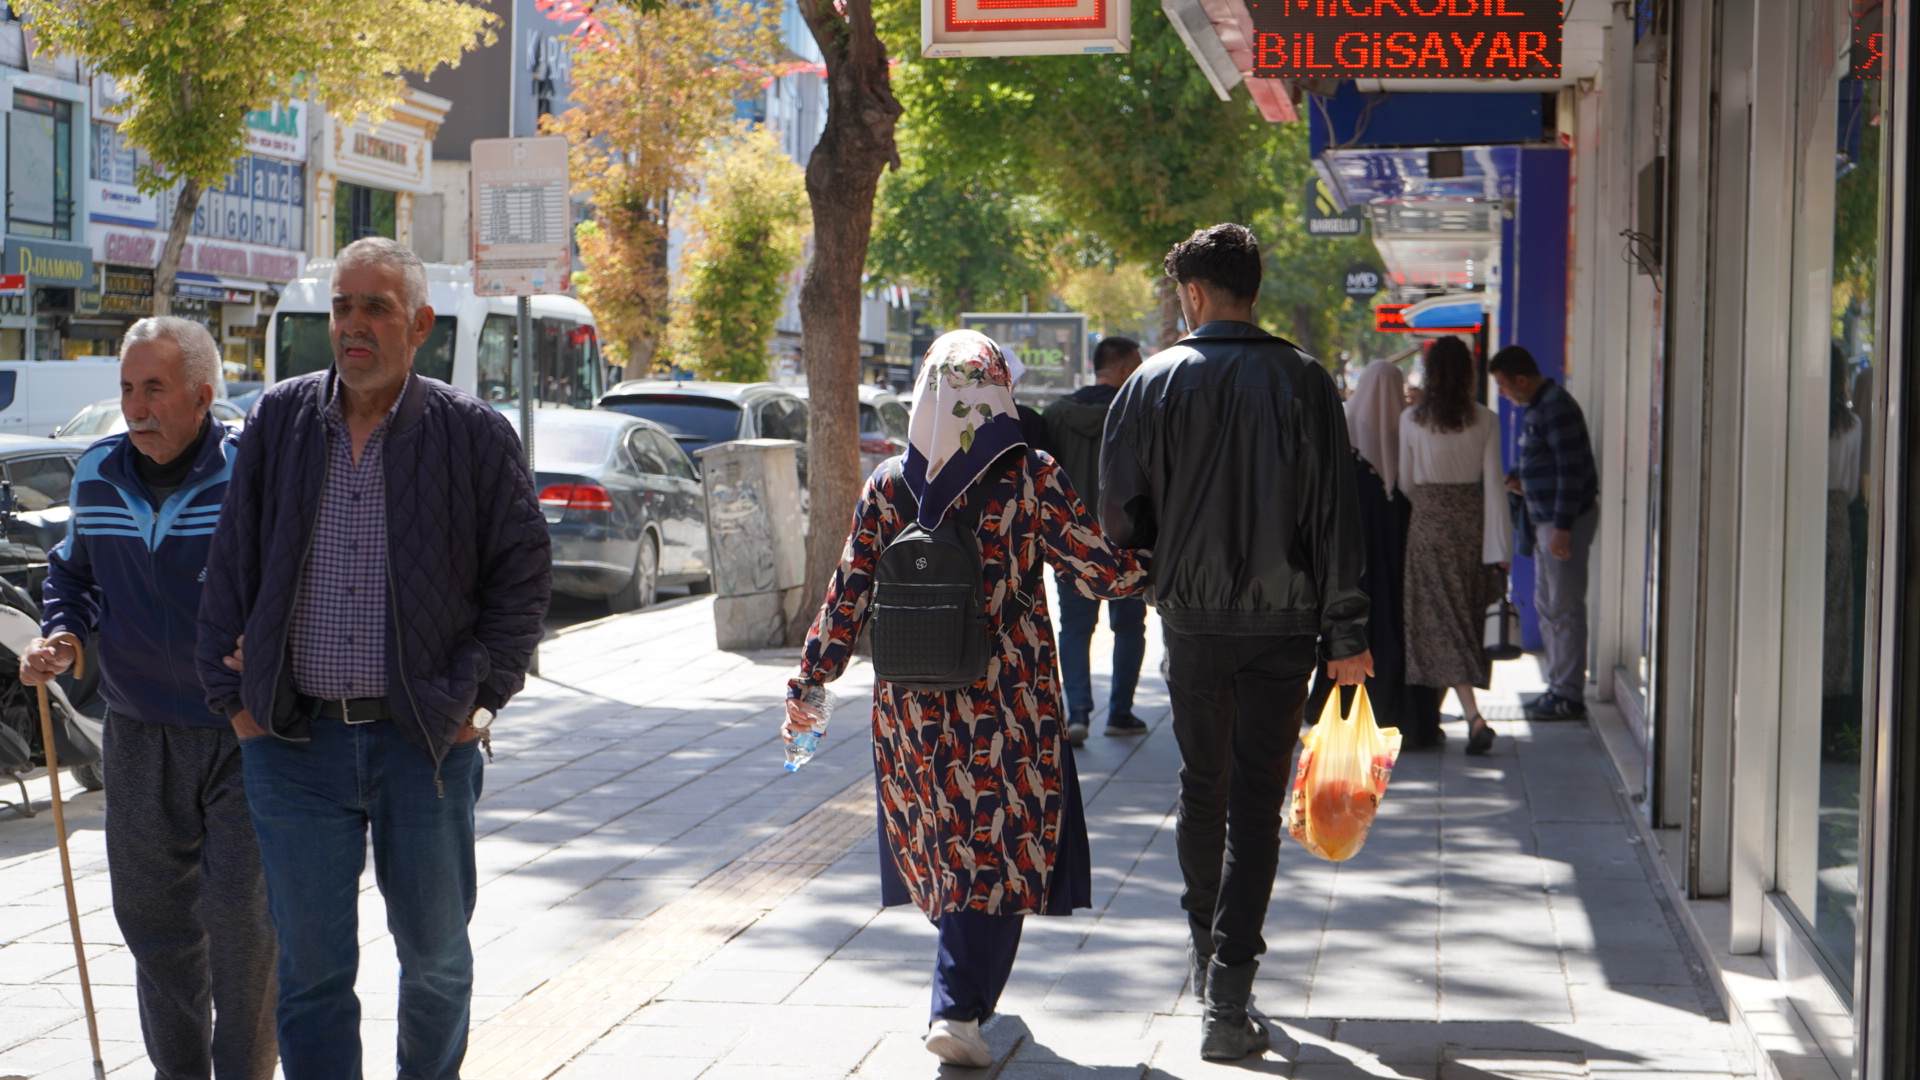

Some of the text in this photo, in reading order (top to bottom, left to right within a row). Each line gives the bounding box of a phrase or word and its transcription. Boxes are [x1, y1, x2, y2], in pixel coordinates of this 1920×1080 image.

[514, 148, 527, 165] P
[197, 197, 288, 243] SİGORTA
[1310, 218, 1357, 233] BARGELLO
